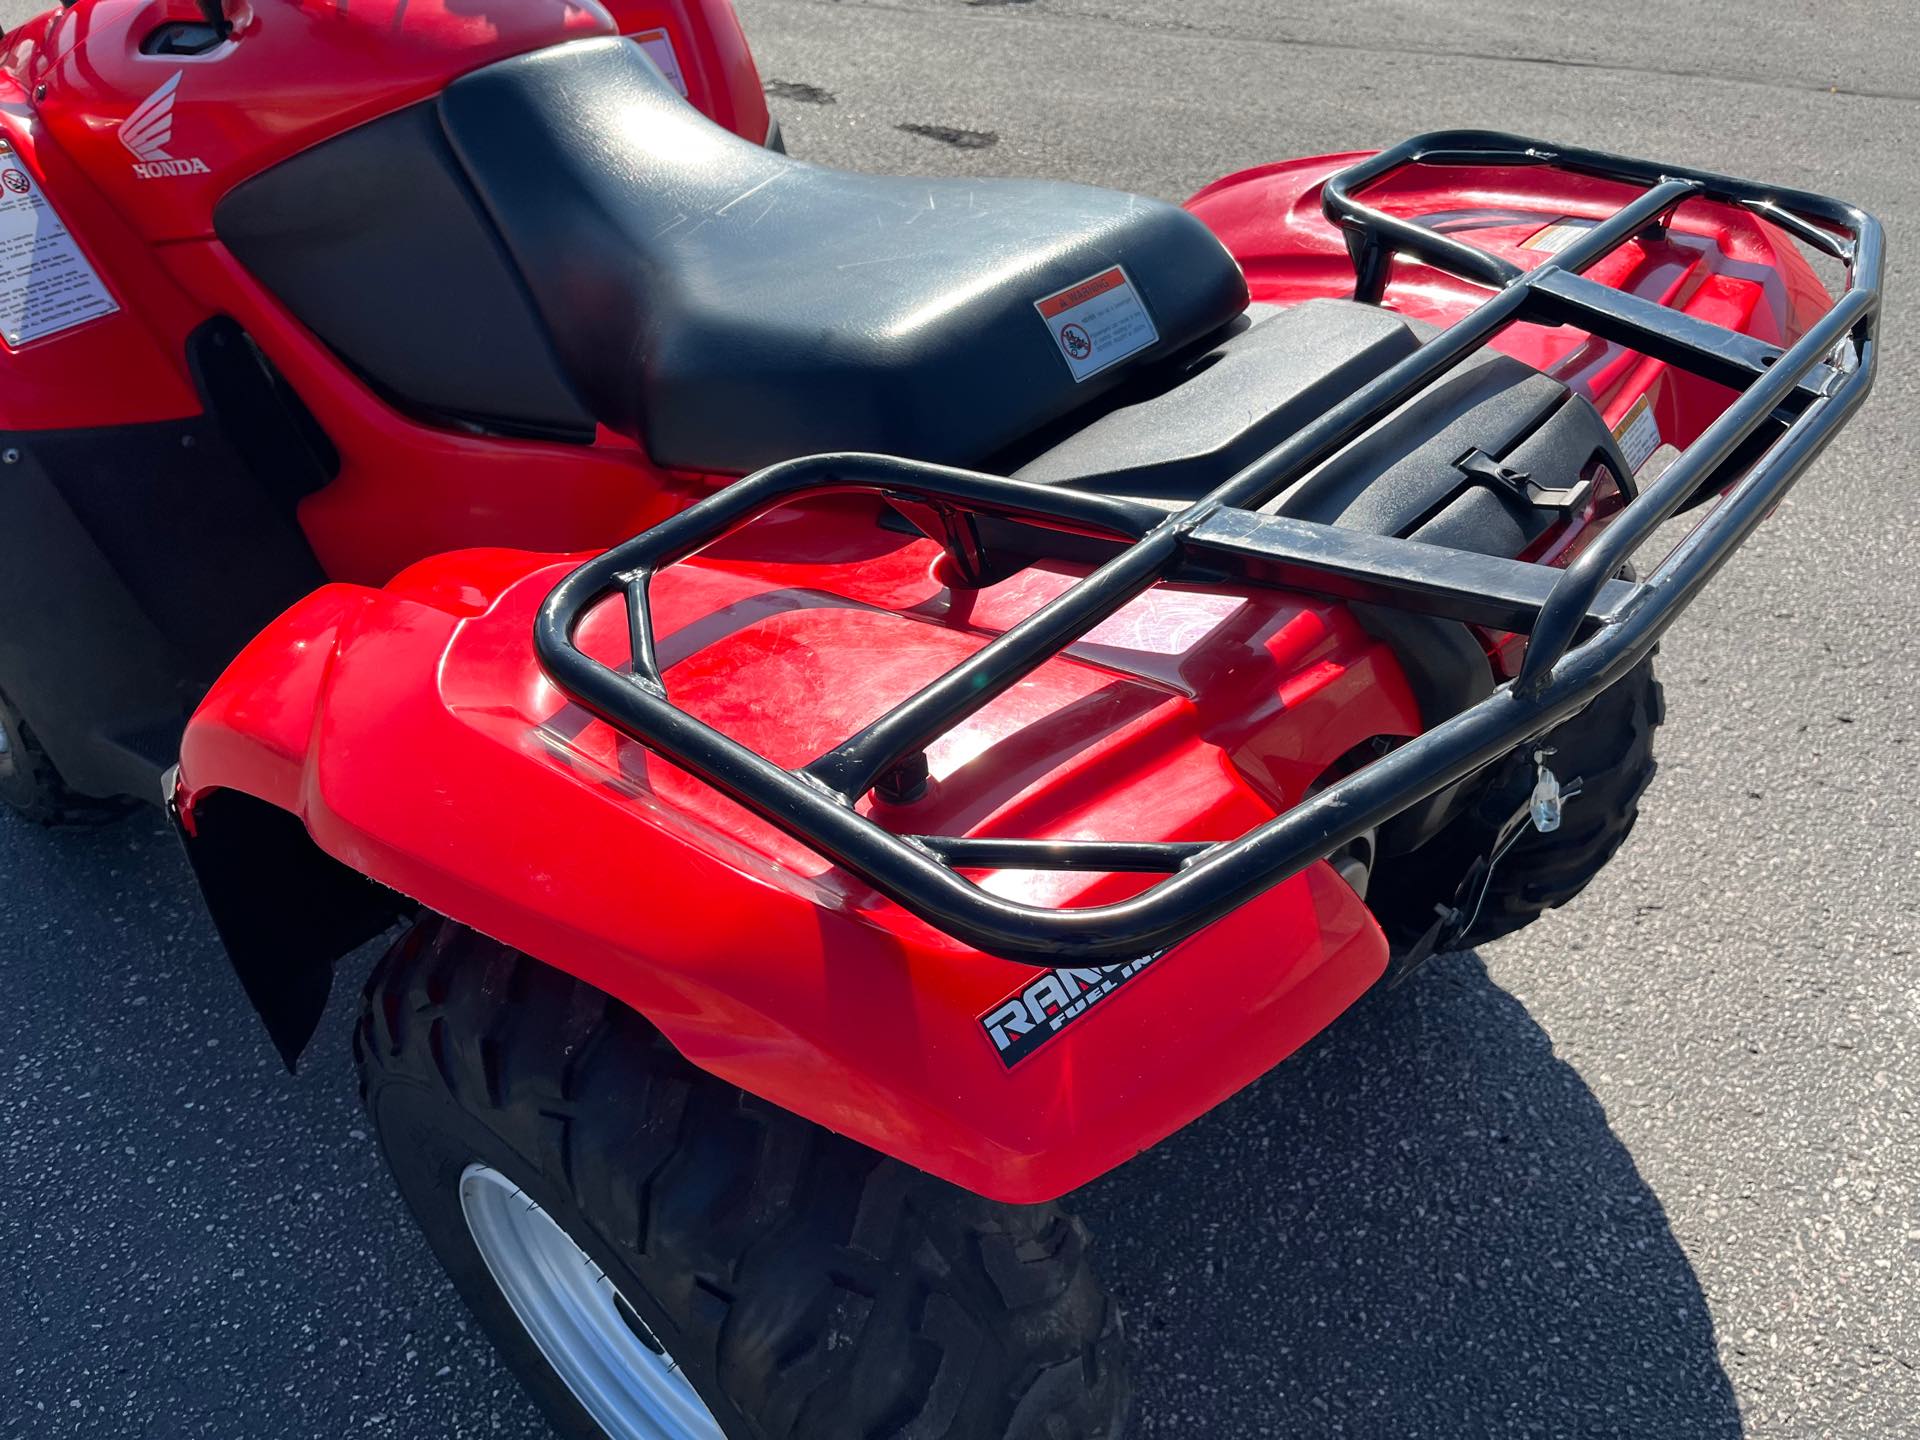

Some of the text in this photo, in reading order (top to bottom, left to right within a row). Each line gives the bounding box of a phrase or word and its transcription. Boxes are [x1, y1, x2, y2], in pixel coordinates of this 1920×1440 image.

[132, 158, 211, 179] HONDA
[1067, 279, 1110, 302] WARNING
[1049, 979, 1118, 1031] FUEL
